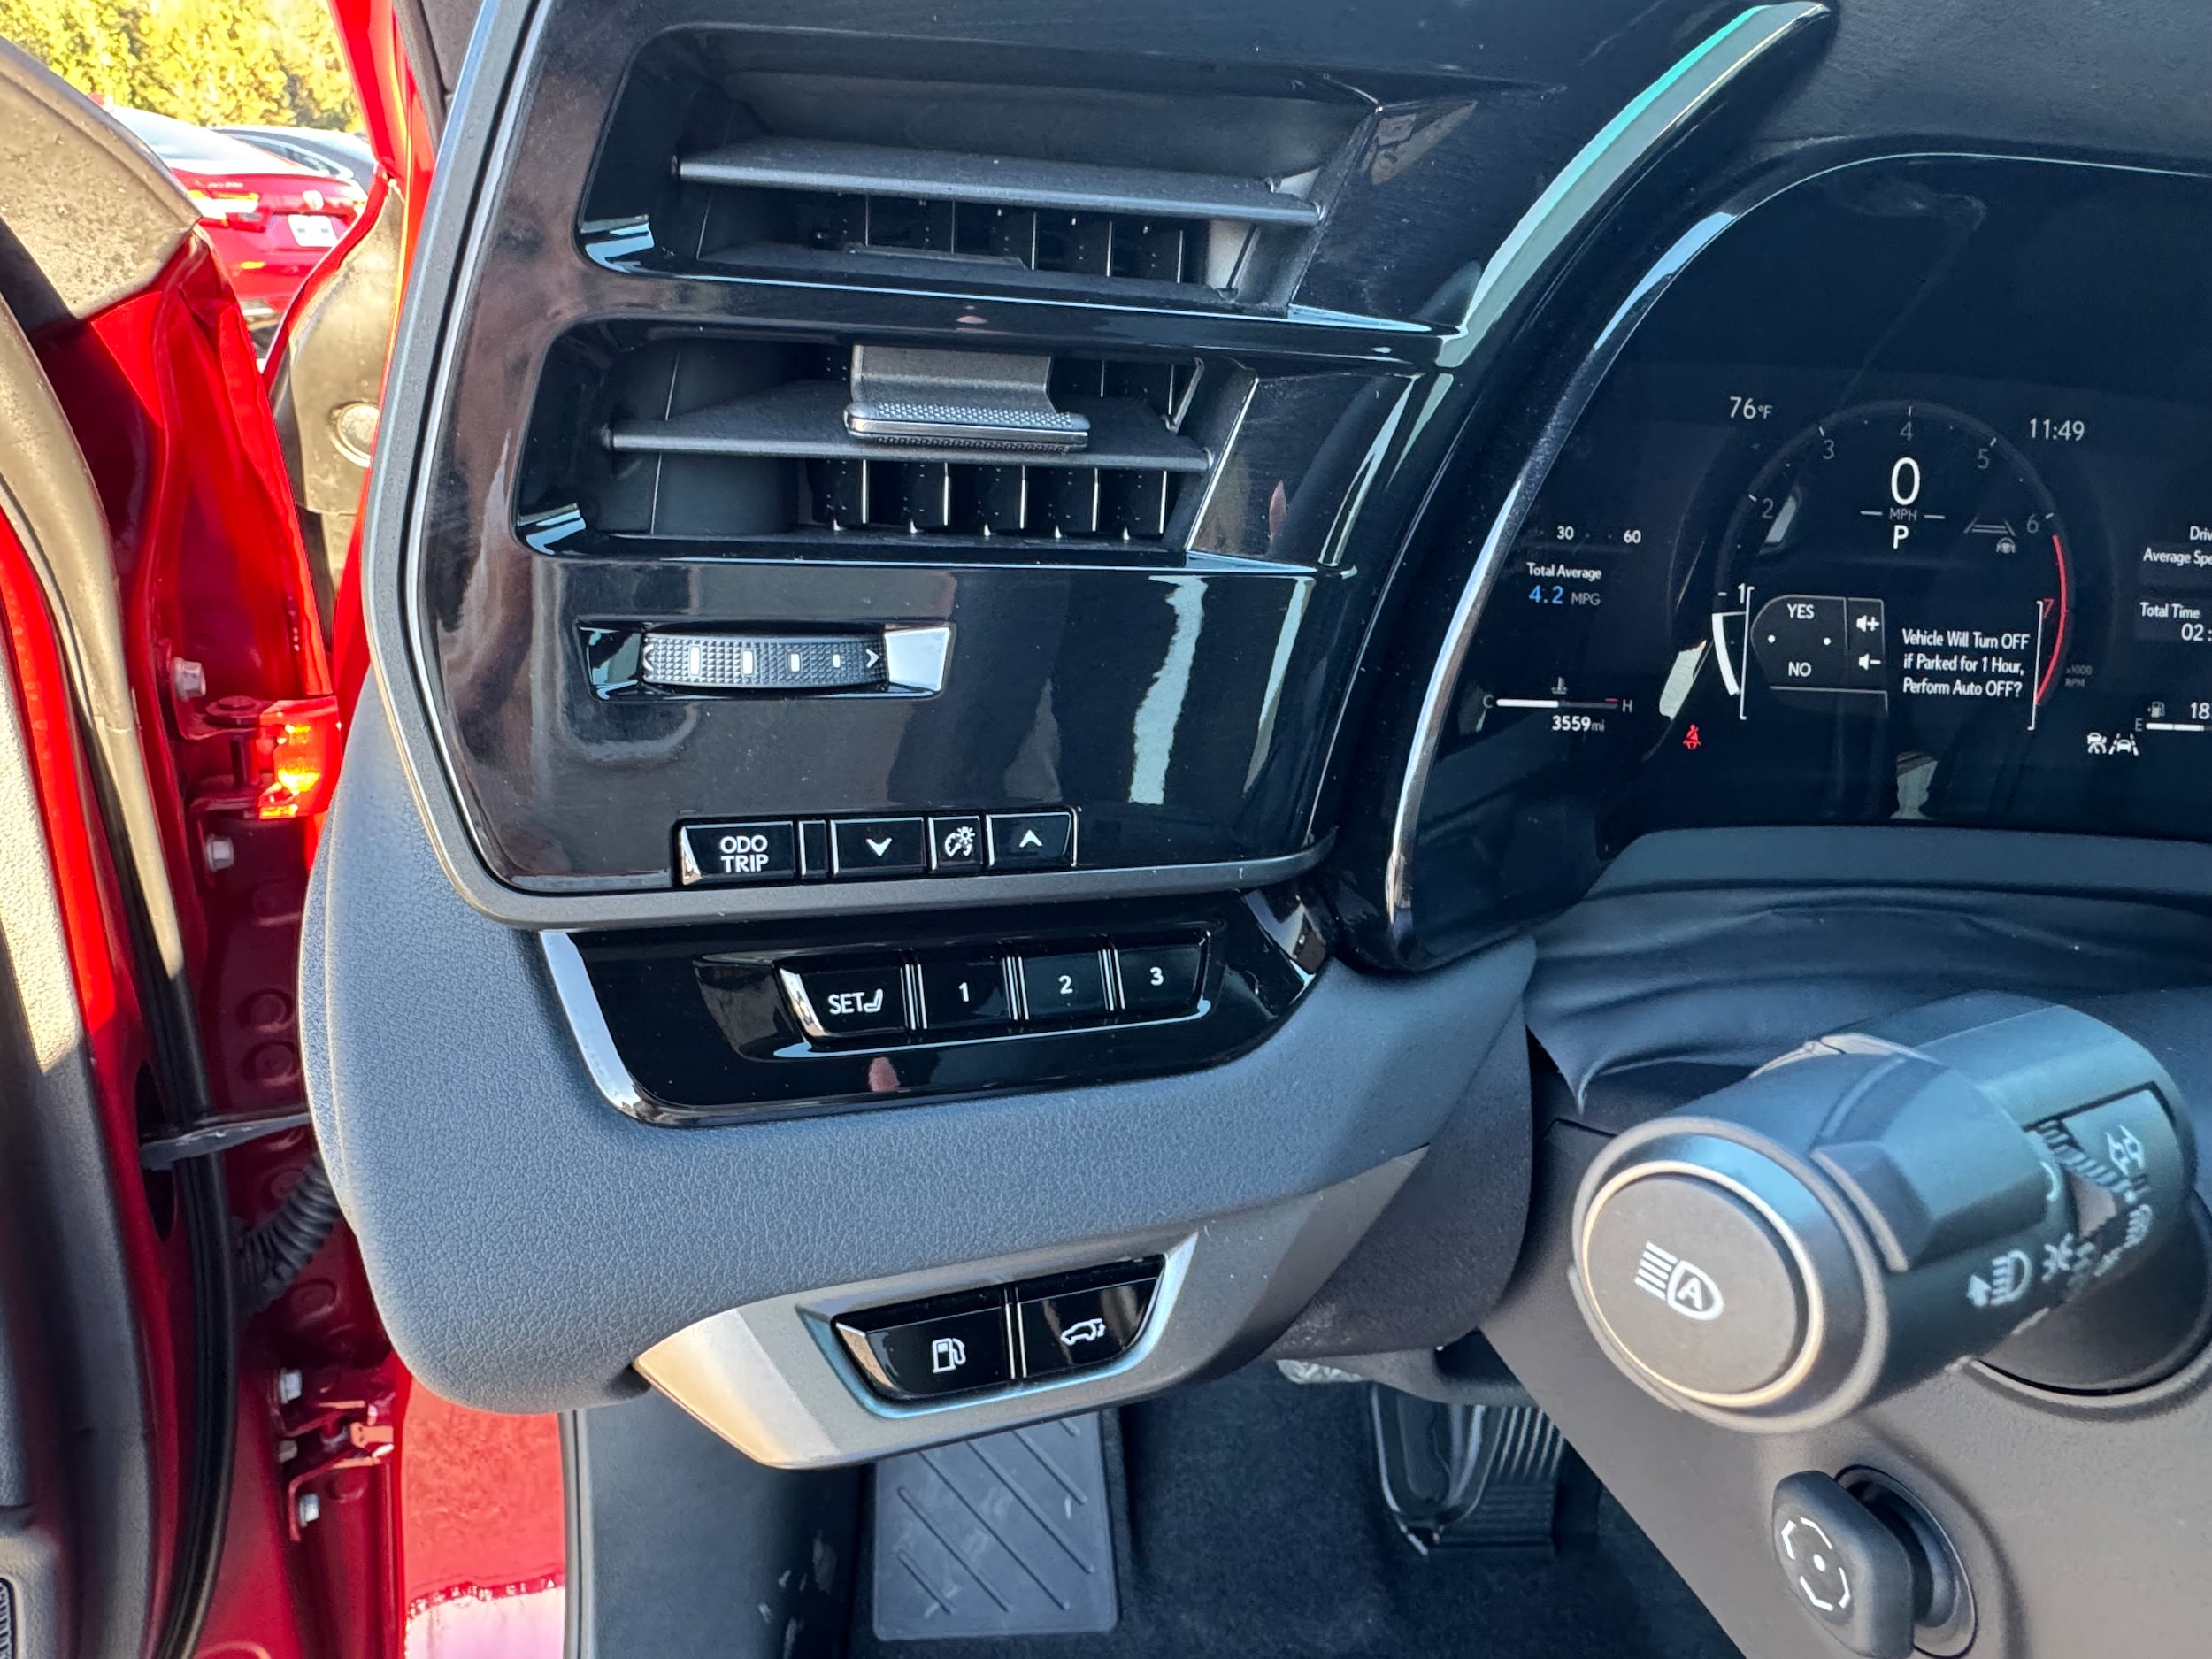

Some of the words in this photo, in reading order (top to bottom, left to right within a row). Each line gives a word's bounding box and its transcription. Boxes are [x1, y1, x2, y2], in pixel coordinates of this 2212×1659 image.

[1900, 421, 1914, 441] 4
[2030, 418, 2085, 441] 11:49
[1823, 439, 1835, 460] 3
[1978, 448, 1990, 469] 5
[1891, 457, 1921, 505] 0
[1762, 498, 1774, 519] 2
[1889, 508, 1918, 522] MPH
[1556, 526, 1575, 541] 30
[2026, 513, 2039, 534] 6
[1623, 530, 1642, 544] 60
[1893, 524, 1909, 549] P
[2143, 547, 2192, 567] Average
[1526, 561, 1555, 578] Total
[1556, 564, 1602, 582] Average
[1528, 585, 1564, 605] 4.2
[1571, 592, 1601, 606] MPG
[1738, 583, 1746, 604] 1
[1786, 603, 1815, 619] YES
[2043, 598, 2055, 619] 7
[2139, 602, 2170, 618] Total
[2171, 603, 2200, 619] Time
[1901, 627, 1944, 647] Vehicle
[1947, 630, 1970, 648] Will
[1972, 631, 1999, 649] Turn
[2001, 633, 2031, 650] OFF
[1788, 661, 1812, 678] NO
[1903, 653, 1914, 670] if
[1916, 653, 1958, 672] Parked
[1960, 656, 1978, 672] for
[1982, 657, 1988, 672] 1
[1991, 657, 2025, 677] Hour,
[1902, 676, 1950, 695] Perform
[1952, 679, 1983, 696] Auto
[1985, 680, 2024, 698] OFF?
[1482, 694, 1494, 709] C
[1622, 699, 1633, 713] H
[2190, 701, 2212, 720] 18
[2134, 717, 2144, 733] E
[720, 834, 768, 854] ODO
[720, 854, 770, 873] TRIP
[1058, 975, 1073, 995] 2
[1149, 966, 1164, 987] 3
[958, 982, 970, 1002] 1
[827, 992, 865, 1016] SET
